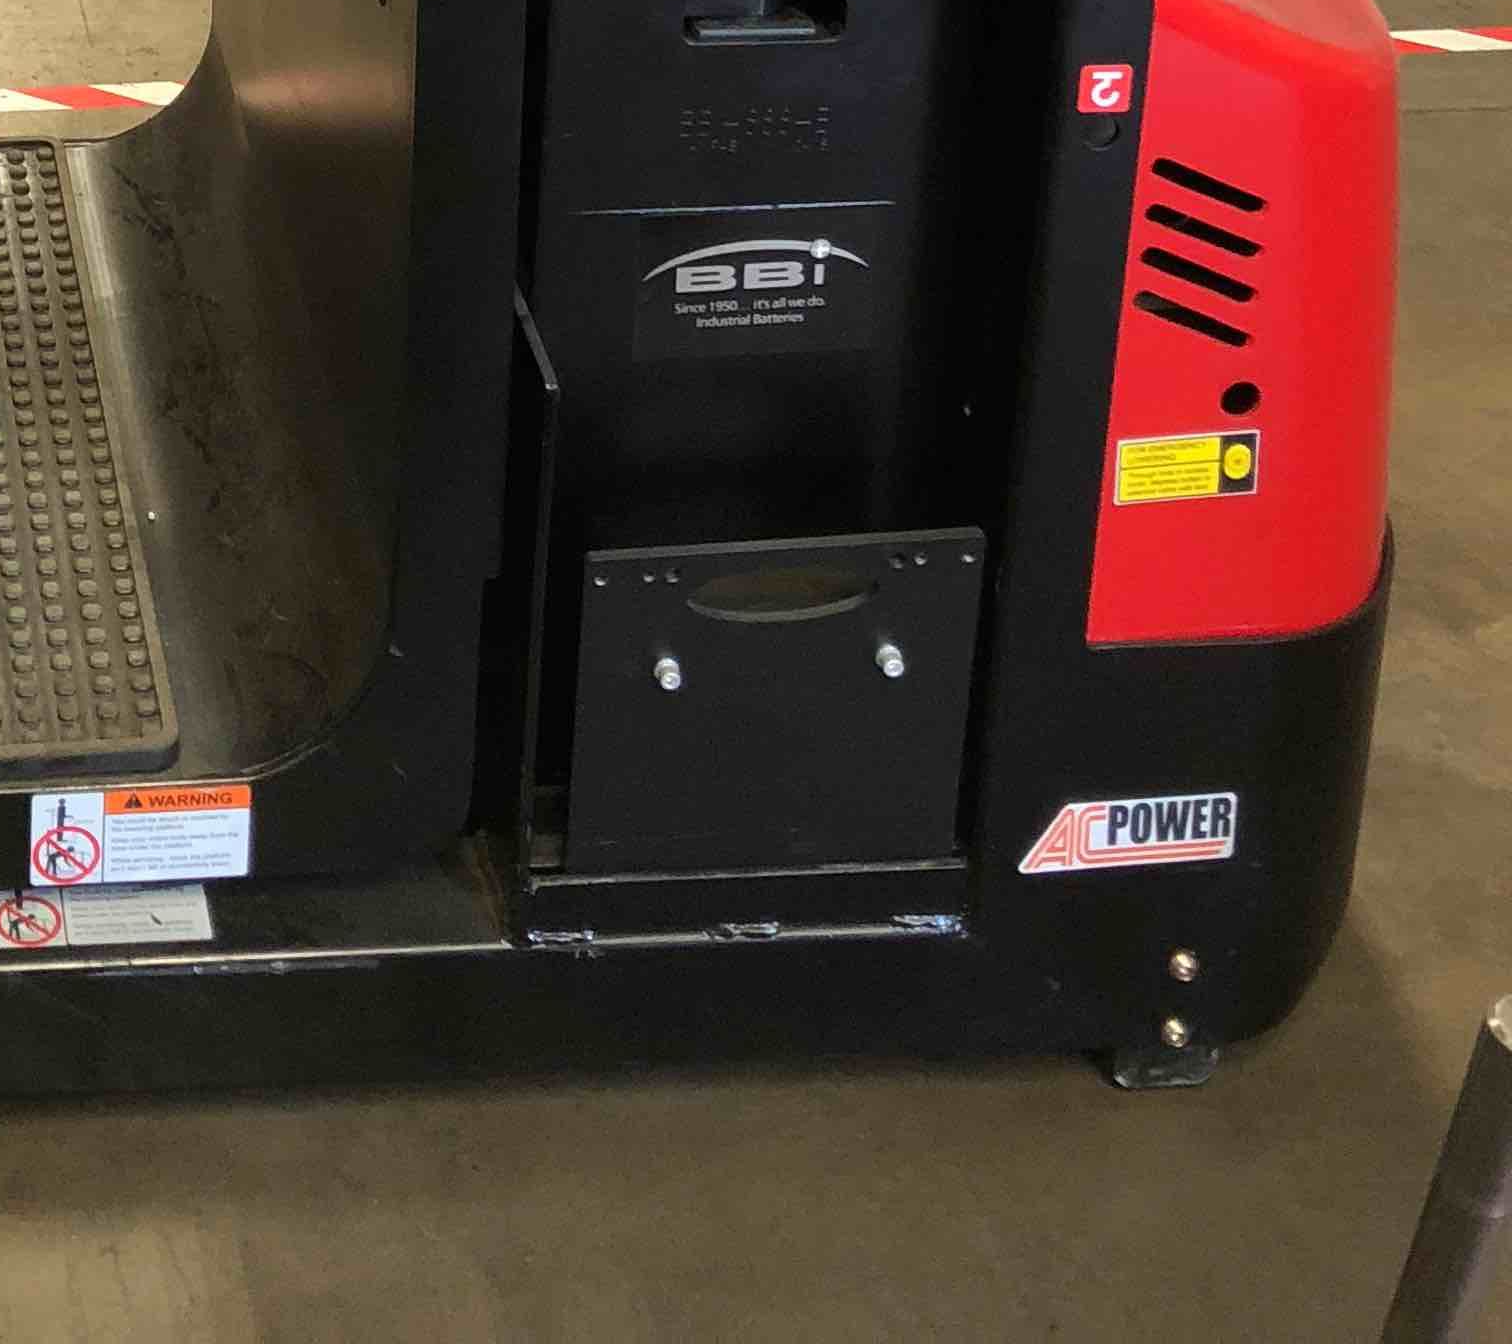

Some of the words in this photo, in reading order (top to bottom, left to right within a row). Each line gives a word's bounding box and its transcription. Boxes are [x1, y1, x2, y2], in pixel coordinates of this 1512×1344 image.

[674, 302, 706, 314] Since
[772, 296, 787, 308] all
[789, 297, 806, 308] we
[696, 313, 750, 328] Industrial
[753, 312, 804, 325] Batteries
[148, 792, 232, 807] WARNING
[1023, 803, 1106, 868] AC
[1107, 797, 1233, 846] POWER
